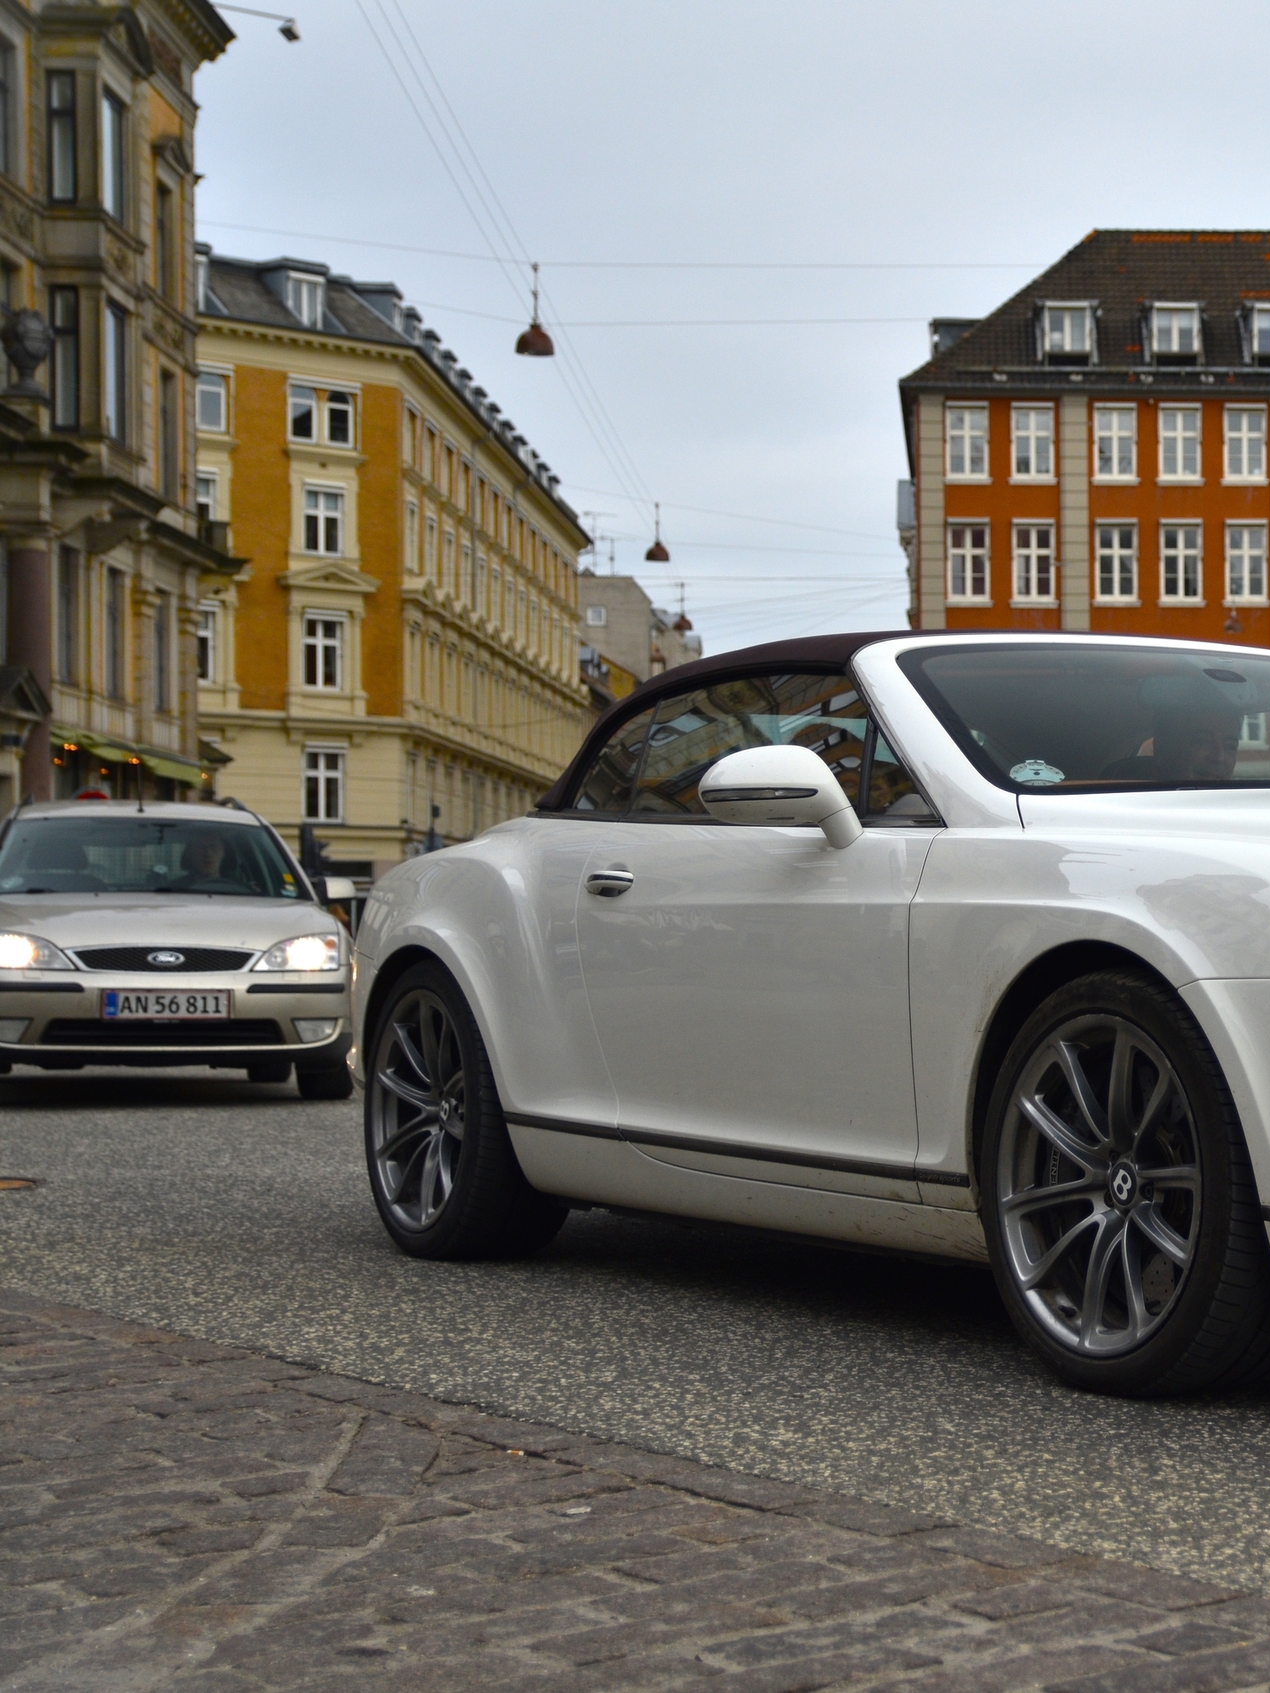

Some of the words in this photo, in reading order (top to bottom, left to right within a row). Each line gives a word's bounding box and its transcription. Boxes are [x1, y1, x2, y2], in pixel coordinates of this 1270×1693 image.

[120, 995, 148, 1013] AN
[154, 995, 180, 1013] 56
[186, 995, 222, 1013] 811
